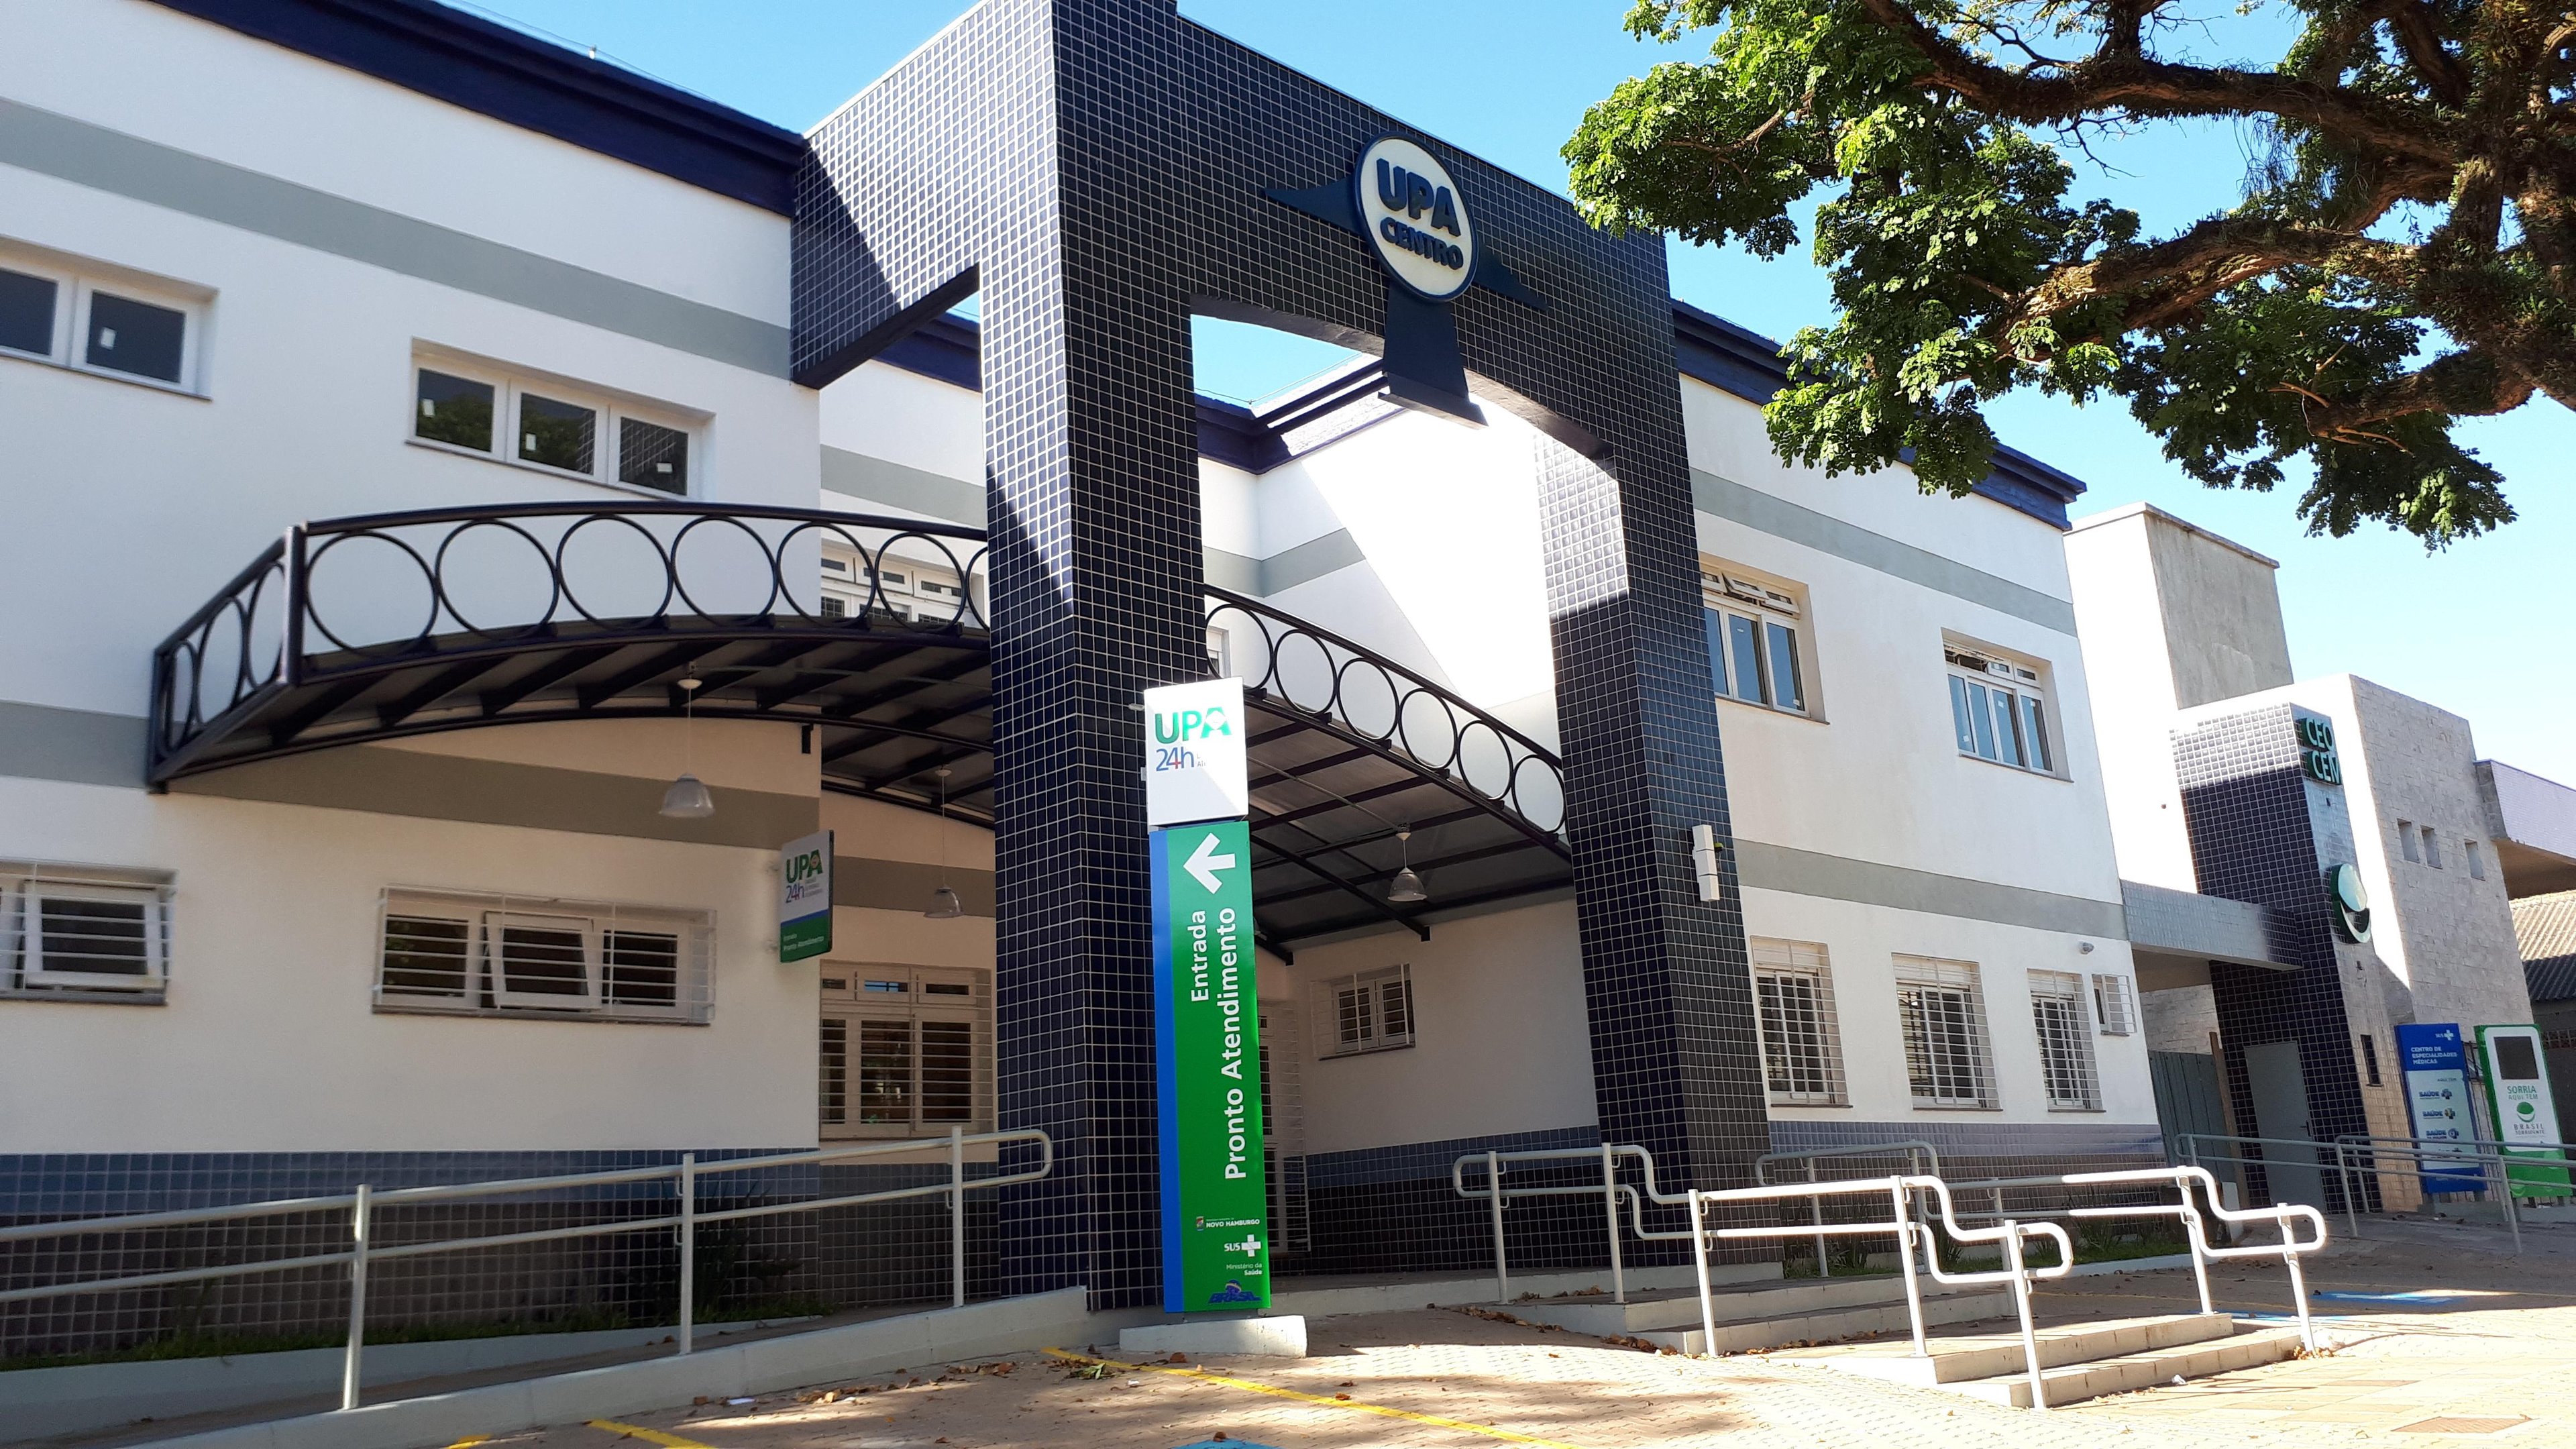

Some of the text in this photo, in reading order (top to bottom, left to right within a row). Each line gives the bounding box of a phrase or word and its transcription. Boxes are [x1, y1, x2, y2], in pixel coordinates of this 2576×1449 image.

[1377, 158, 1461, 237] UPA
[1380, 217, 1464, 270] CENTRO
[1155, 706, 1232, 745] UPA
[2306, 718, 2334, 751] CEO
[1156, 746, 1194, 771] 24h
[786, 849, 823, 883] UPA
[786, 883, 804, 904] 24h
[1187, 910, 1210, 1002] Entrada
[1216, 908, 1246, 1179] Pronto Atendimento
[2507, 1085, 2536, 1093] SORRIA
[1226, 1219, 1260, 1227] HAMBURGO
[1224, 1242, 1240, 1252] SUS
